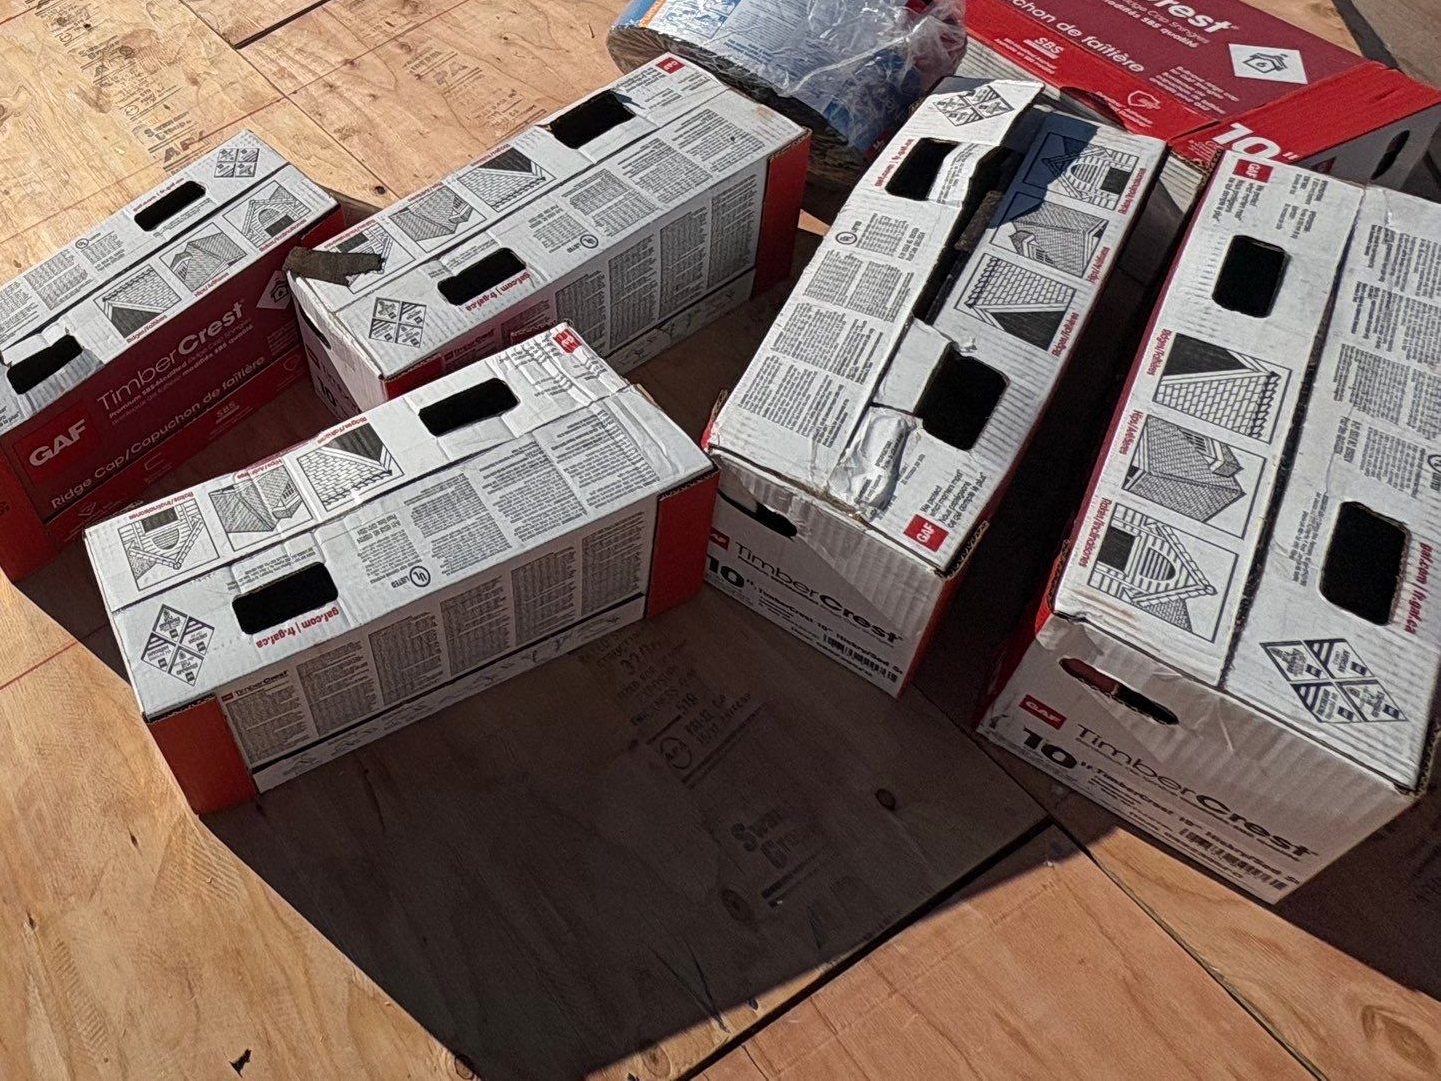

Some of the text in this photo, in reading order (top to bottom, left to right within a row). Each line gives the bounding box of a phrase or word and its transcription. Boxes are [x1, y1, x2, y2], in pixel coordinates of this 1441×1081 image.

[1141, 17, 1161, 30] SBS
[1034, 37, 1064, 54] SBS
[1057, 22, 1083, 38] de
[1083, 34, 1145, 74] faîtière
[1245, 163, 1260, 178] GAF
[29, 419, 86, 466] GAF
[51, 357, 265, 509] Ridge Cap/Capuchon de faîtière
[916, 522, 936, 543] GAF
[391, 575, 409, 589] LISTED
[1404, 542, 1433, 635] gaf.com fr.gaf.ca
[255, 605, 340, 648] gaf.com fr.gaf.ca
[235, 670, 289, 696] TimberCrest
[1025, 700, 1060, 723] GAF
